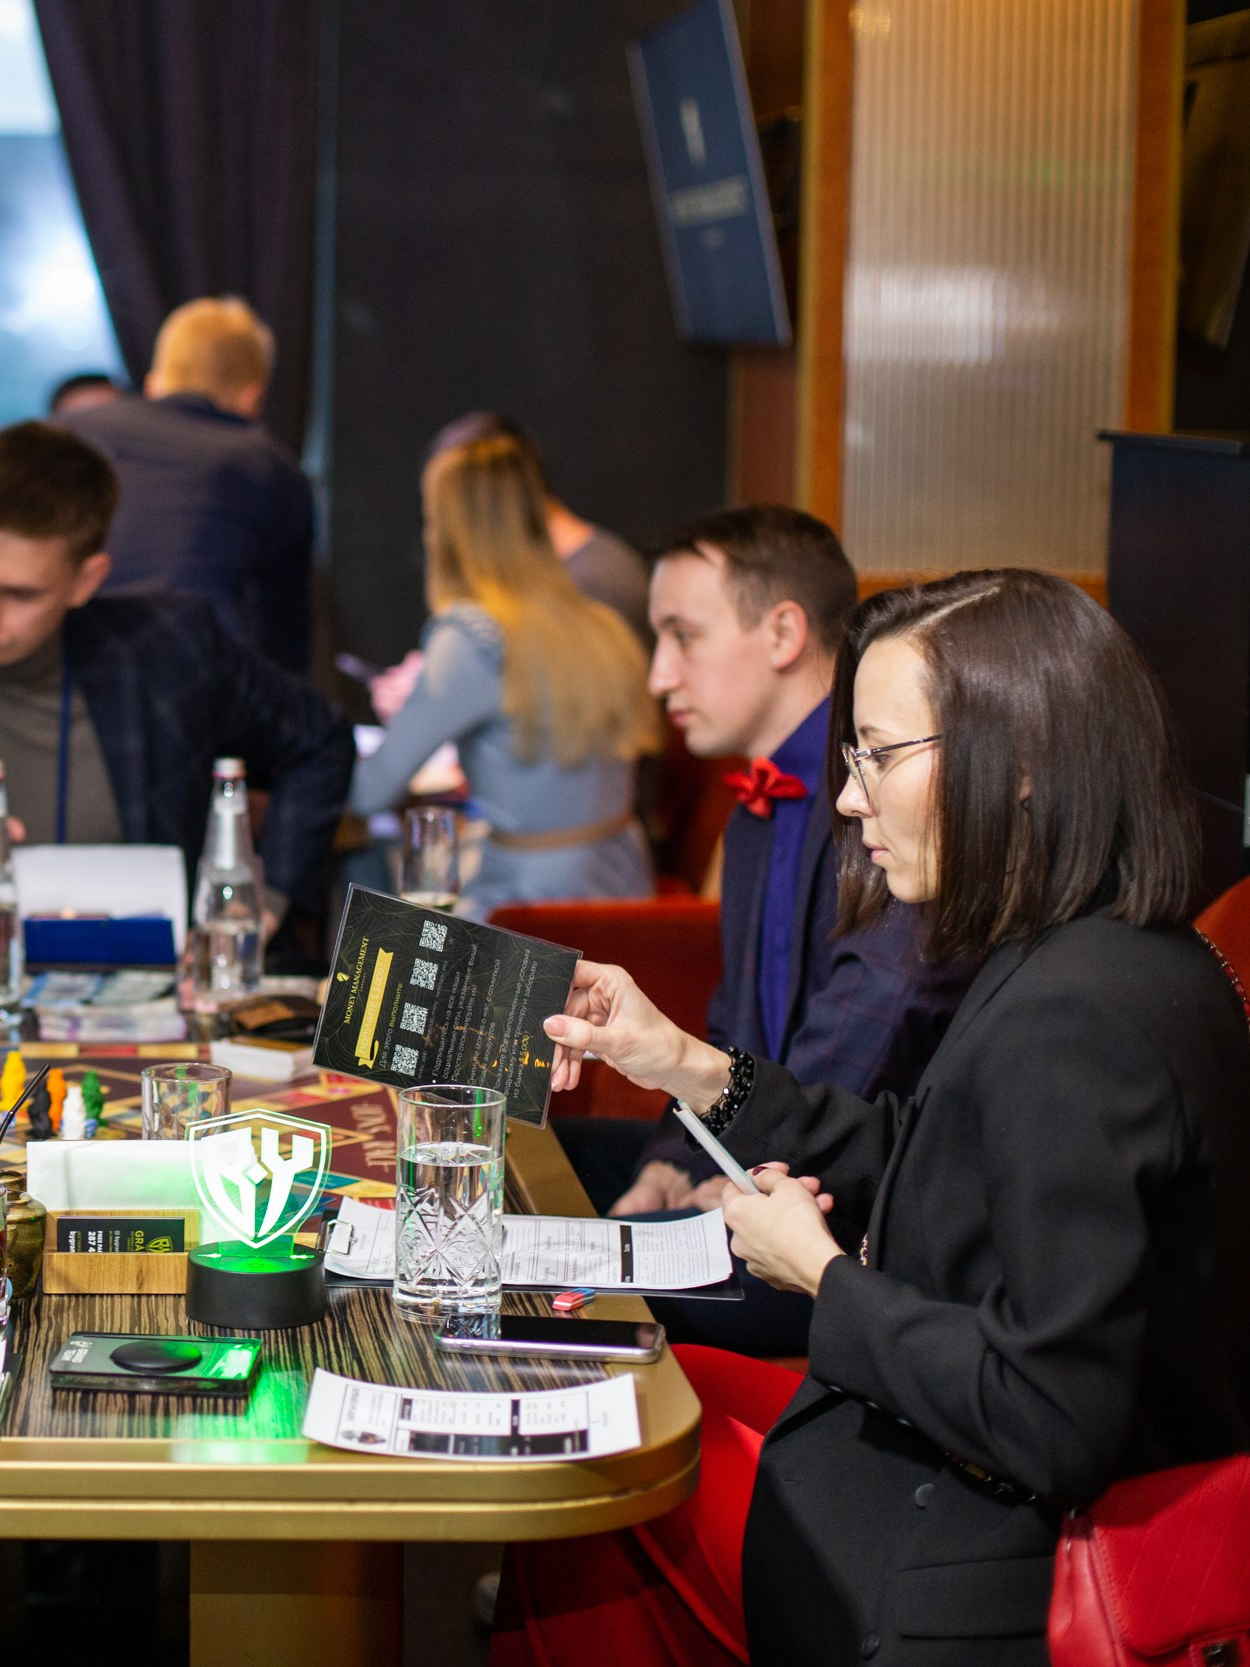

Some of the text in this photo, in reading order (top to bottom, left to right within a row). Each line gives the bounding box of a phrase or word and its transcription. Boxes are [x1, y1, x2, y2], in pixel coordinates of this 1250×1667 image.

[343, 935, 369, 1024] MONEY MANAGEMENT
[504, 982, 522, 1038] выполненные
[517, 948, 531, 982] условия
[514, 1005, 528, 1038] тренеру
[524, 960, 538, 997] заберите
[359, 1000, 377, 1054] ПОЛУЧИТЕ
[383, 1028, 393, 1050] этого
[432, 1020, 450, 1076] Подпишитесь
[451, 971, 461, 993] наши
[442, 1029, 459, 1079] социальные
[457, 966, 473, 1009] указанные
[467, 1050, 480, 1085] Снимте
[486, 958, 501, 995] отметкой
[451, 1050, 463, 1081] Просто
[68, 1230, 77, 1253] bygran
[88, 1231, 96, 1246] 287
[113, 1236, 121, 1253] bygran
[135, 1230, 145, 1252] GRA
